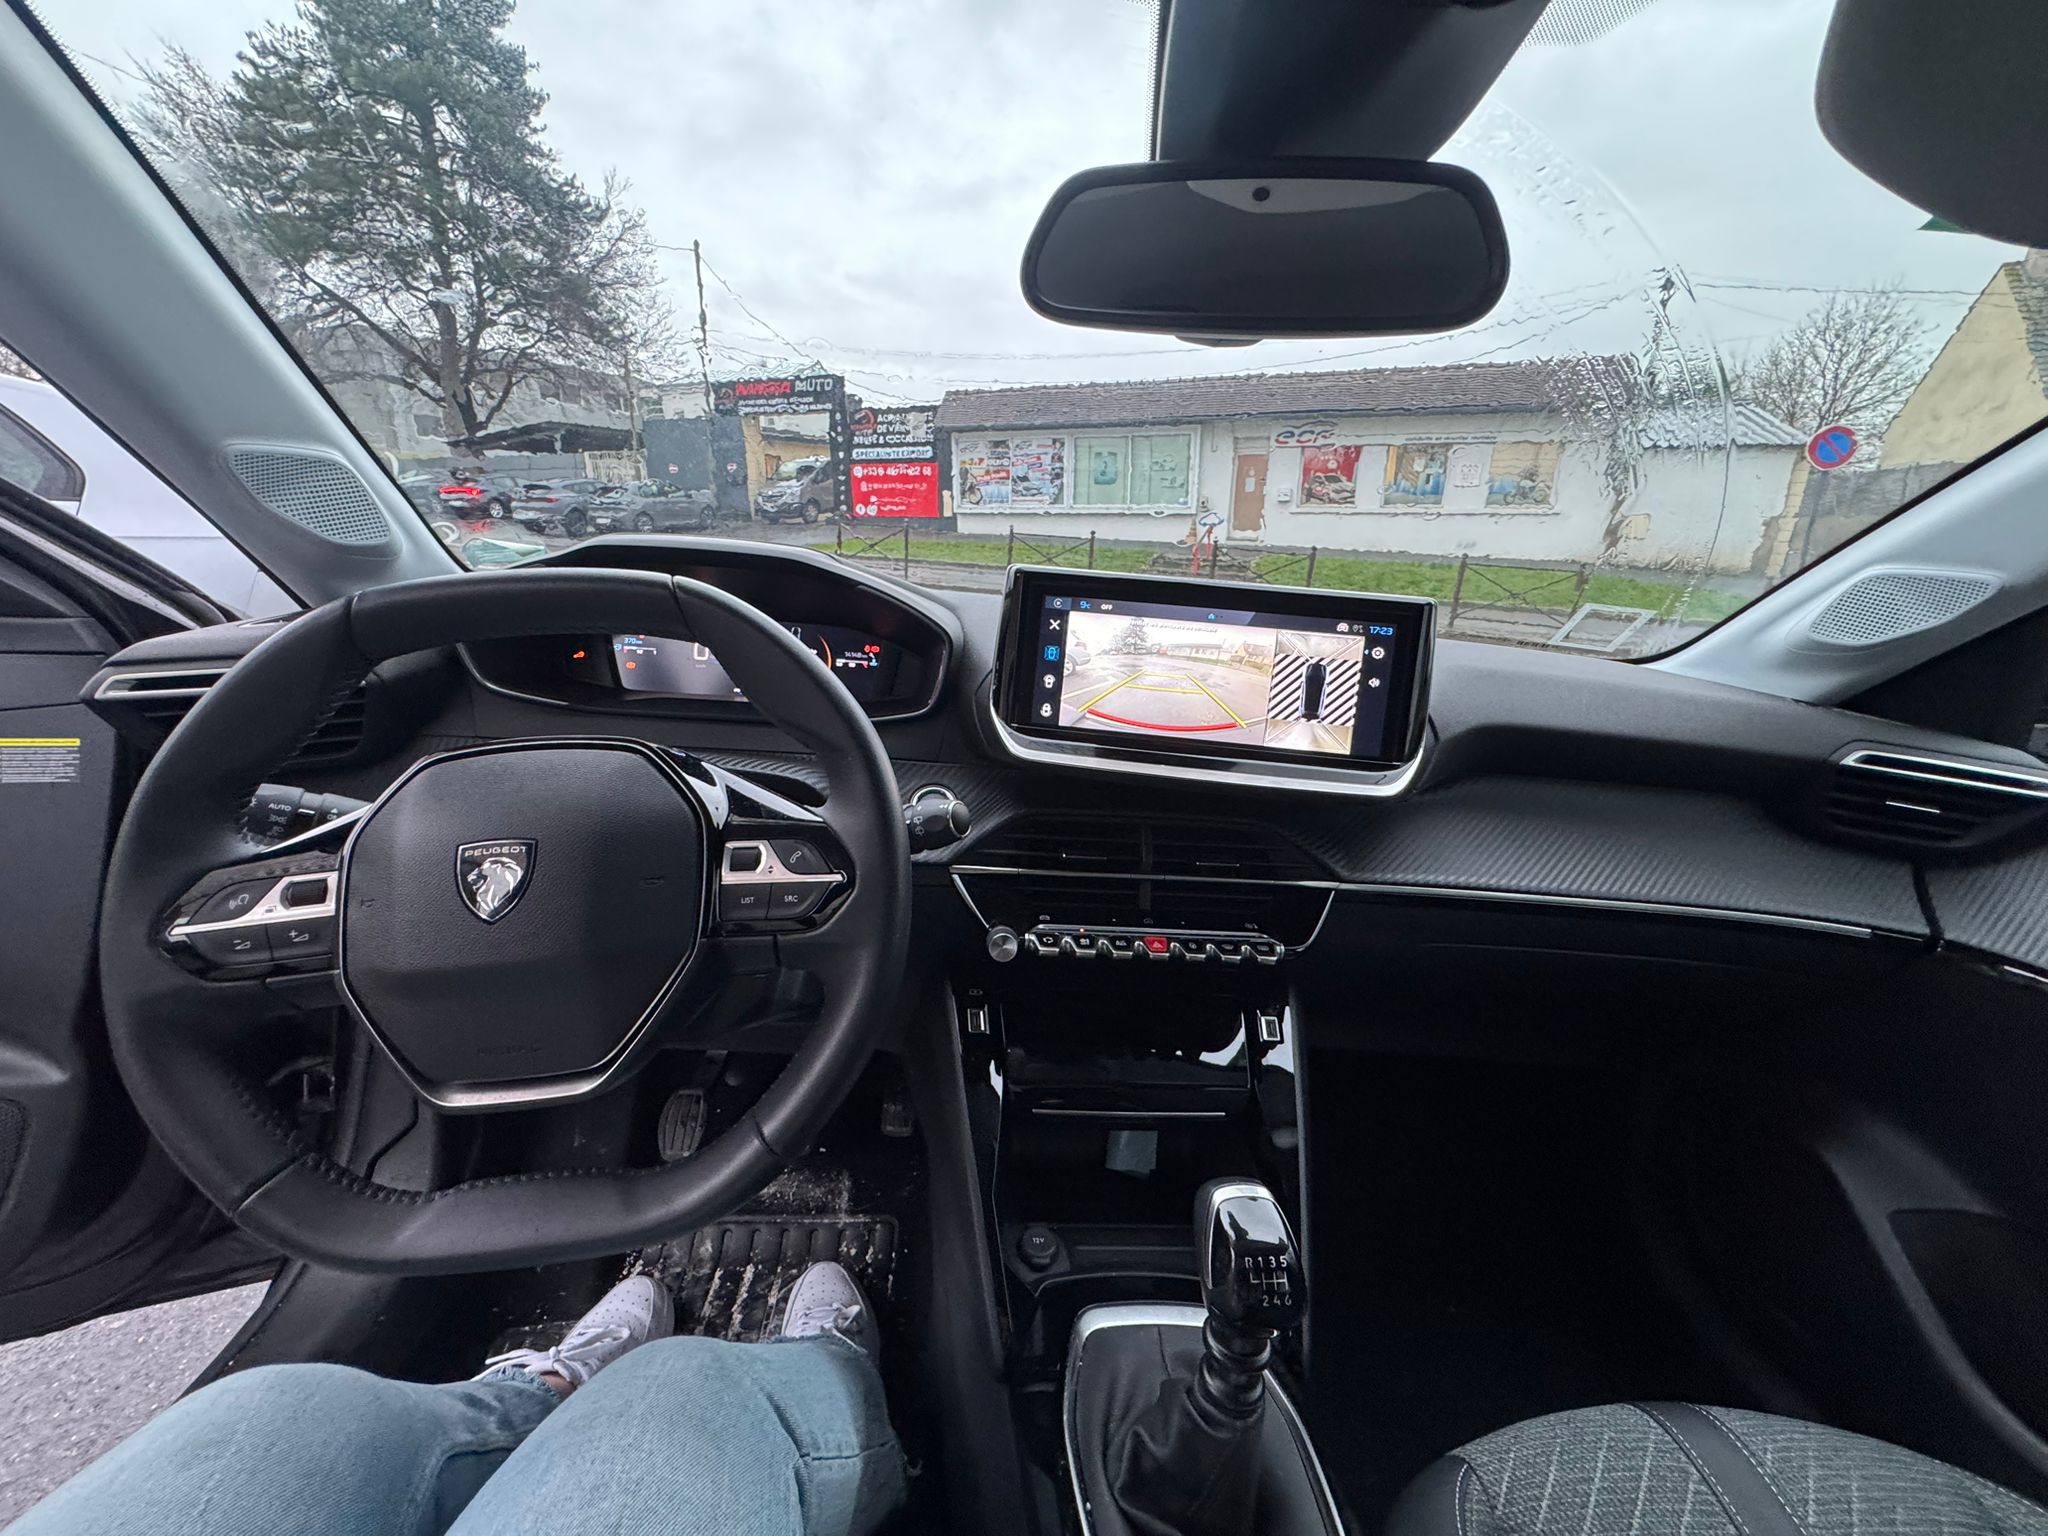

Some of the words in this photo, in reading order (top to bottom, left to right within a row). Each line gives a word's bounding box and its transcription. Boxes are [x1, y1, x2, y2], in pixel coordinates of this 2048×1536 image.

[1369, 626, 1393, 635] 17:23
[268, 802, 292, 811] AUTO
[464, 846, 527, 857] PEUGEOT
[740, 896, 754, 904] LIST
[784, 894, 799, 902] SRC
[1245, 1257, 1253, 1269] R
[1257, 1256, 1263, 1268] 1
[1268, 1255, 1276, 1268] 3
[1279, 1255, 1287, 1268] 5
[1262, 1294, 1269, 1307] 2
[1273, 1294, 1281, 1306] 4
[1284, 1294, 1292, 1306] 6
